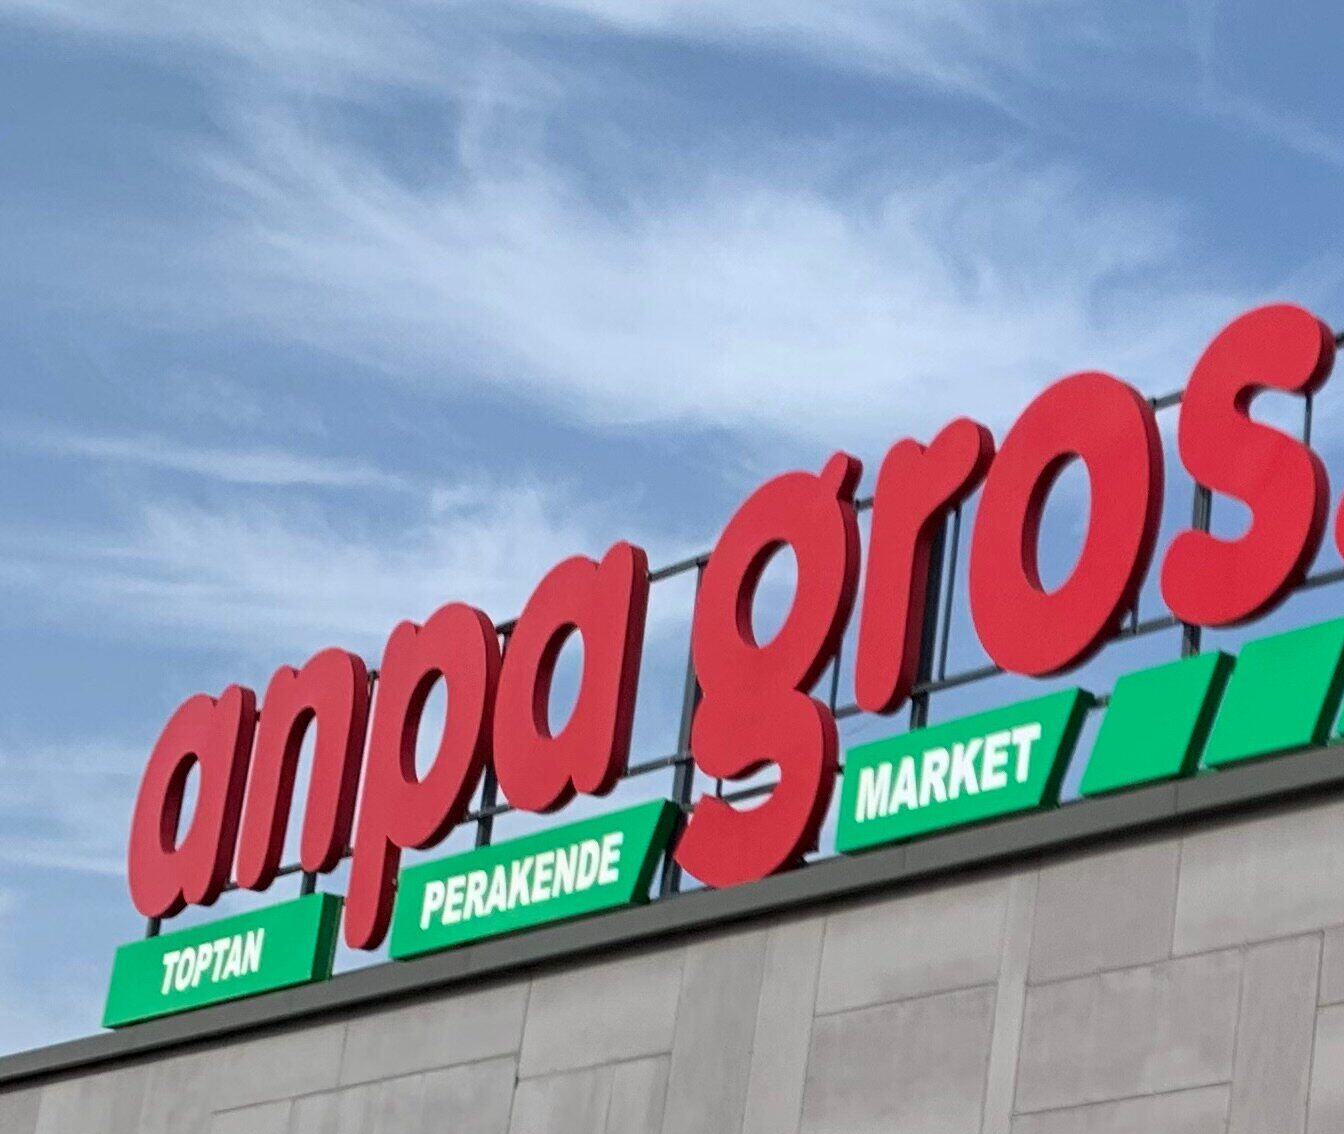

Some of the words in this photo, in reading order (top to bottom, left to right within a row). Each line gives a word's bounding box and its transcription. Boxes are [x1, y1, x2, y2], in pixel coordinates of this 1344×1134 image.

[128, 540, 649, 950] anpa
[161, 927, 265, 996] TOPTAN
[420, 832, 625, 930] PERAKENDE
[854, 723, 1043, 824] MARKET
